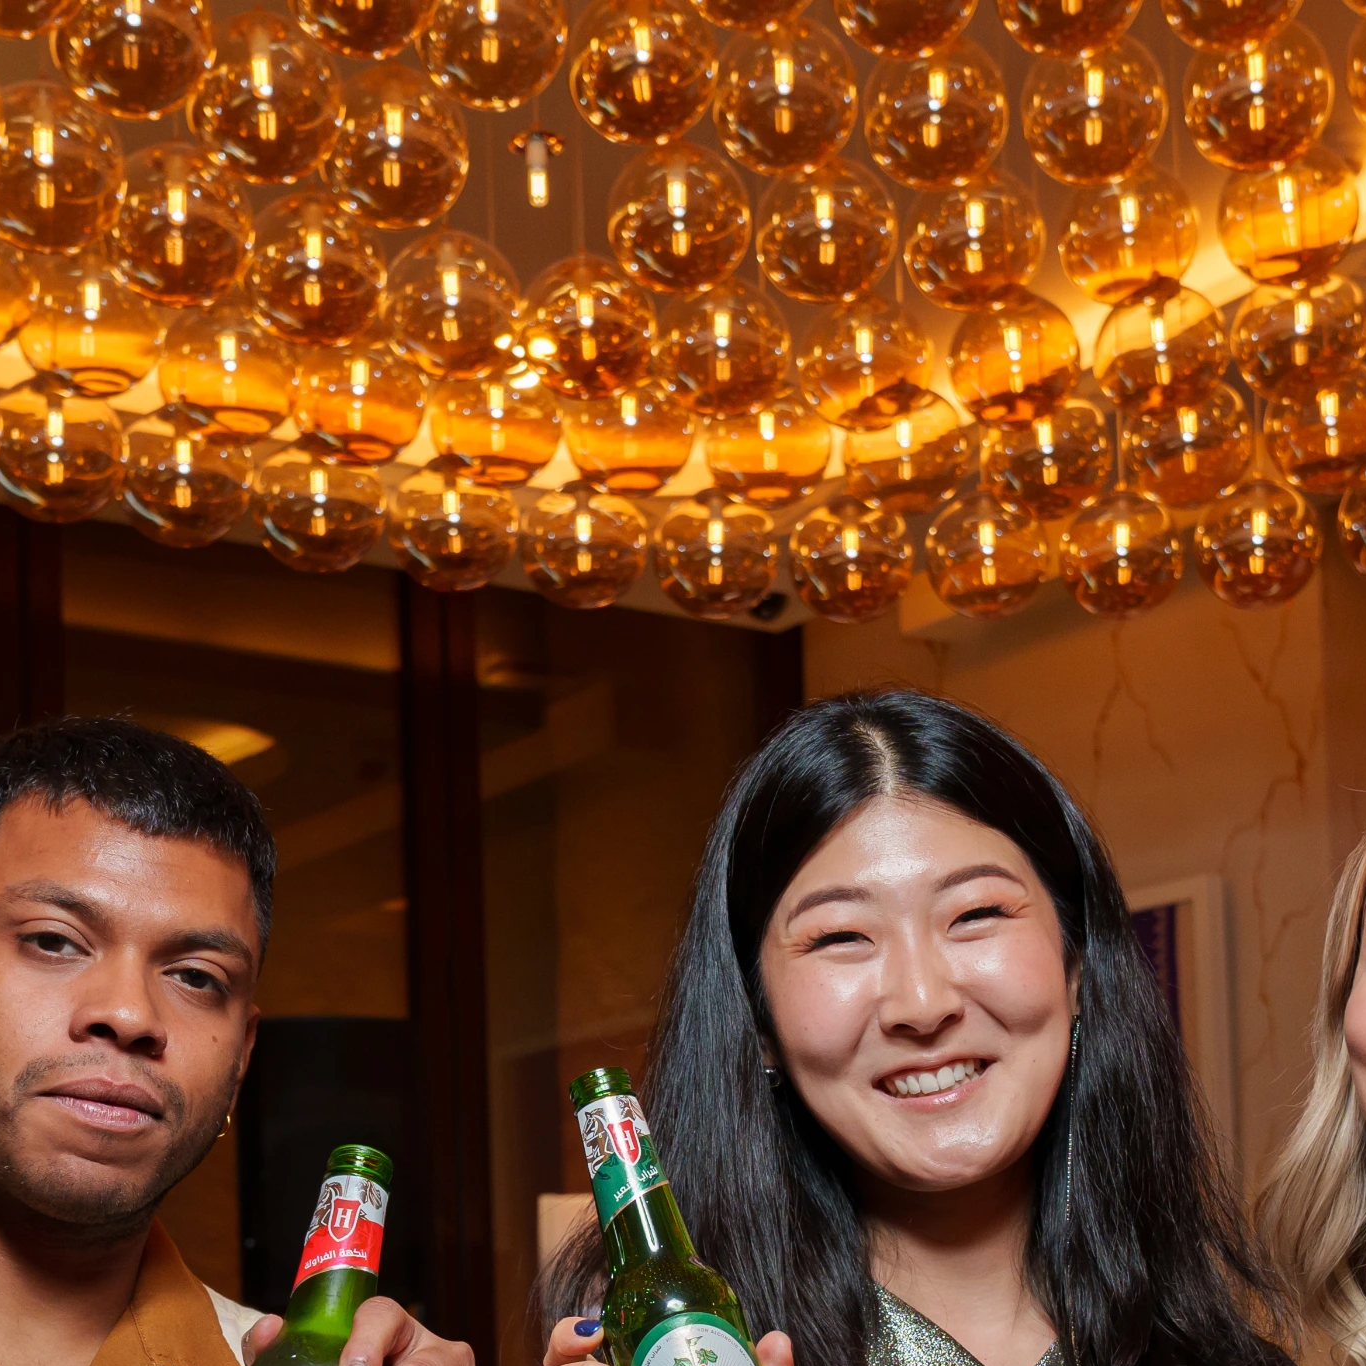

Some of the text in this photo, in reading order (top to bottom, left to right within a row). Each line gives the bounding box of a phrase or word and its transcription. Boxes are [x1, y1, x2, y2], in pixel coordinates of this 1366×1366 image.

[637, 1165, 659, 1182] شراب
[333, 1207, 354, 1229] H
[304, 1247, 368, 1270] بنكهة الفراولة
